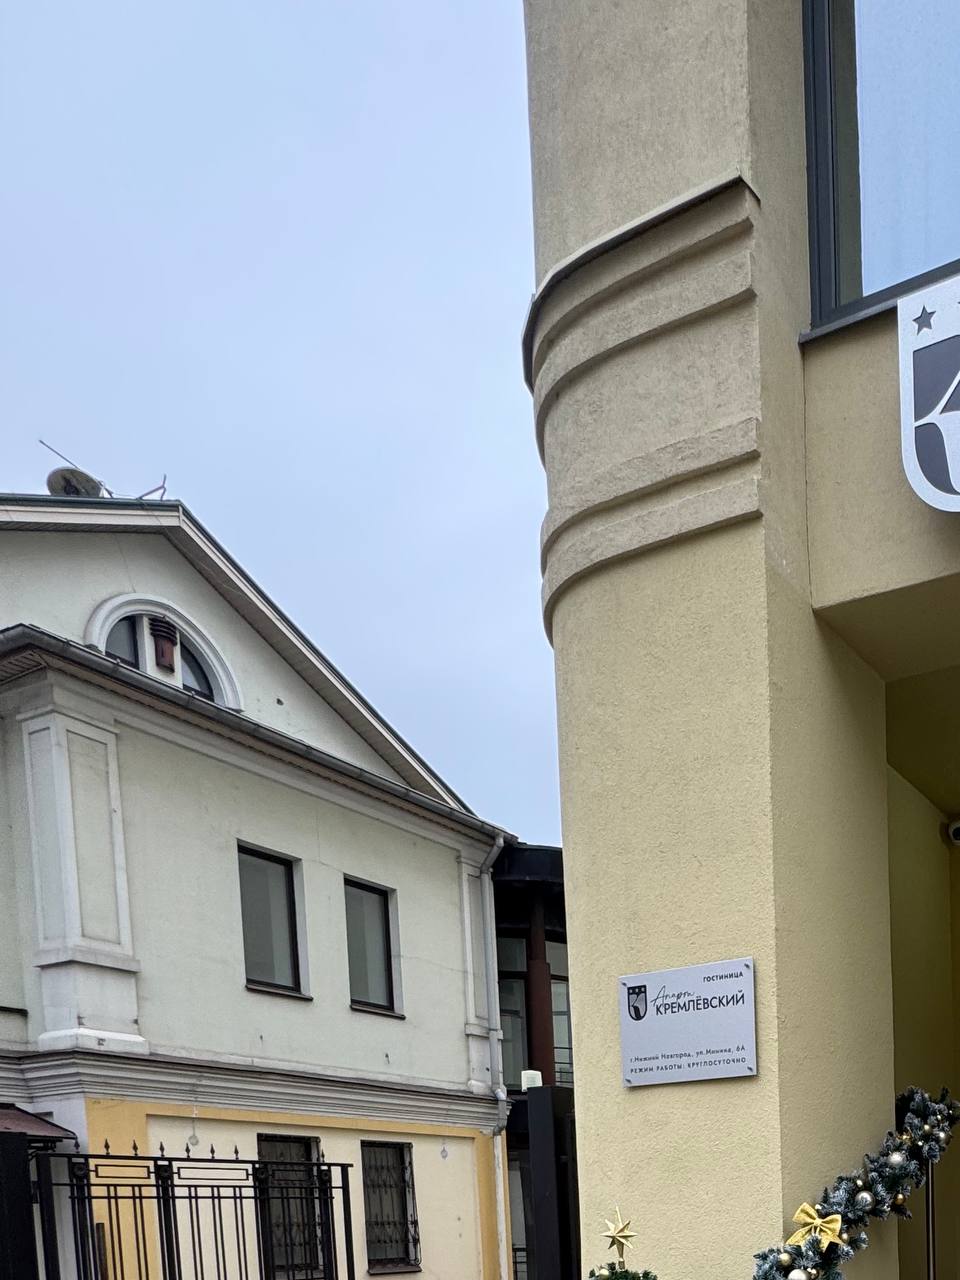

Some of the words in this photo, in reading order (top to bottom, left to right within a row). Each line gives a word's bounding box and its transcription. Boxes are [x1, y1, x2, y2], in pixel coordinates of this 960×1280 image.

[702, 971, 744, 983] ГОСТИНИЦА
[655, 989, 745, 1016] КРЕМЛЁВСКИЙ
[630, 1066, 654, 1074] РЕЖИМ
[687, 1056, 746, 1069] КРУГЛОСУТОЧНО
